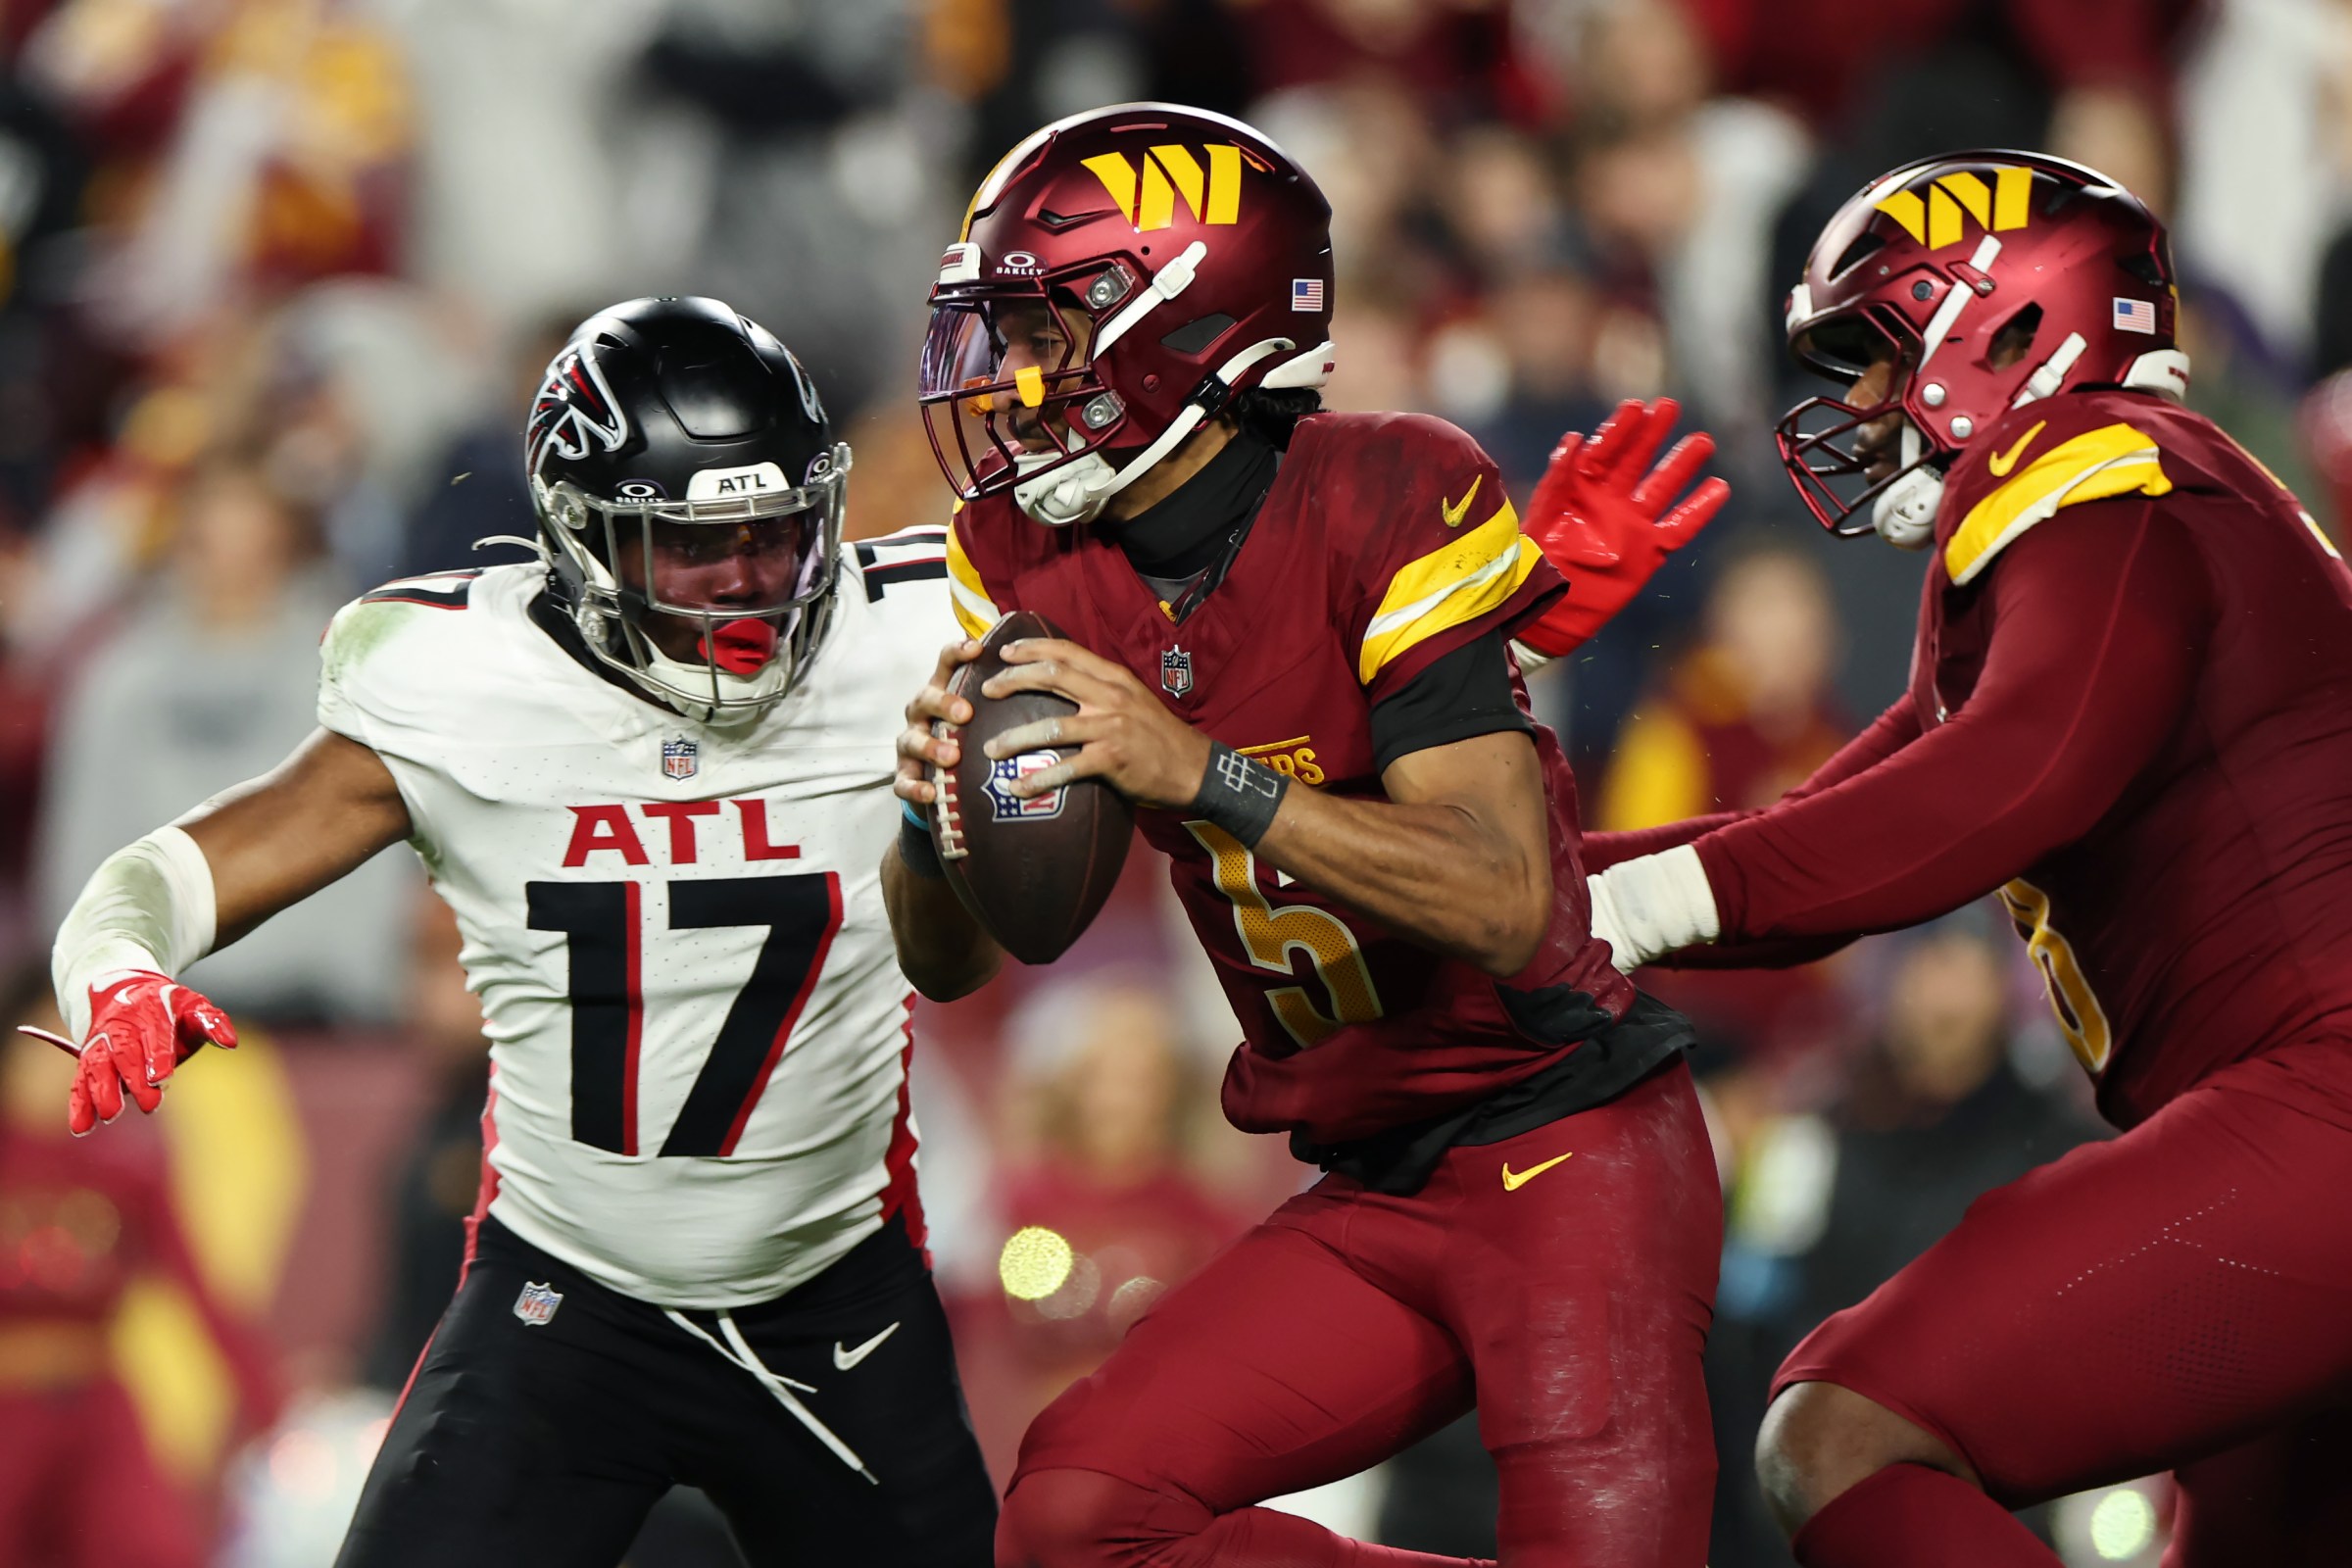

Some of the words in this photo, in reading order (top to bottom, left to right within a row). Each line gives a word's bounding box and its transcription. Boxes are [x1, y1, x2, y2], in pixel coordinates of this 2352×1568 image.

[996, 267, 1044, 275] OAKLEY
[718, 473, 767, 494] ATL
[1165, 669, 1190, 690] NFL
[665, 757, 695, 775] NFL
[562, 799, 801, 867] ATL
[1181, 819, 1384, 1050] 5
[525, 870, 844, 1157] 17
[520, 1298, 549, 1319] NFL
